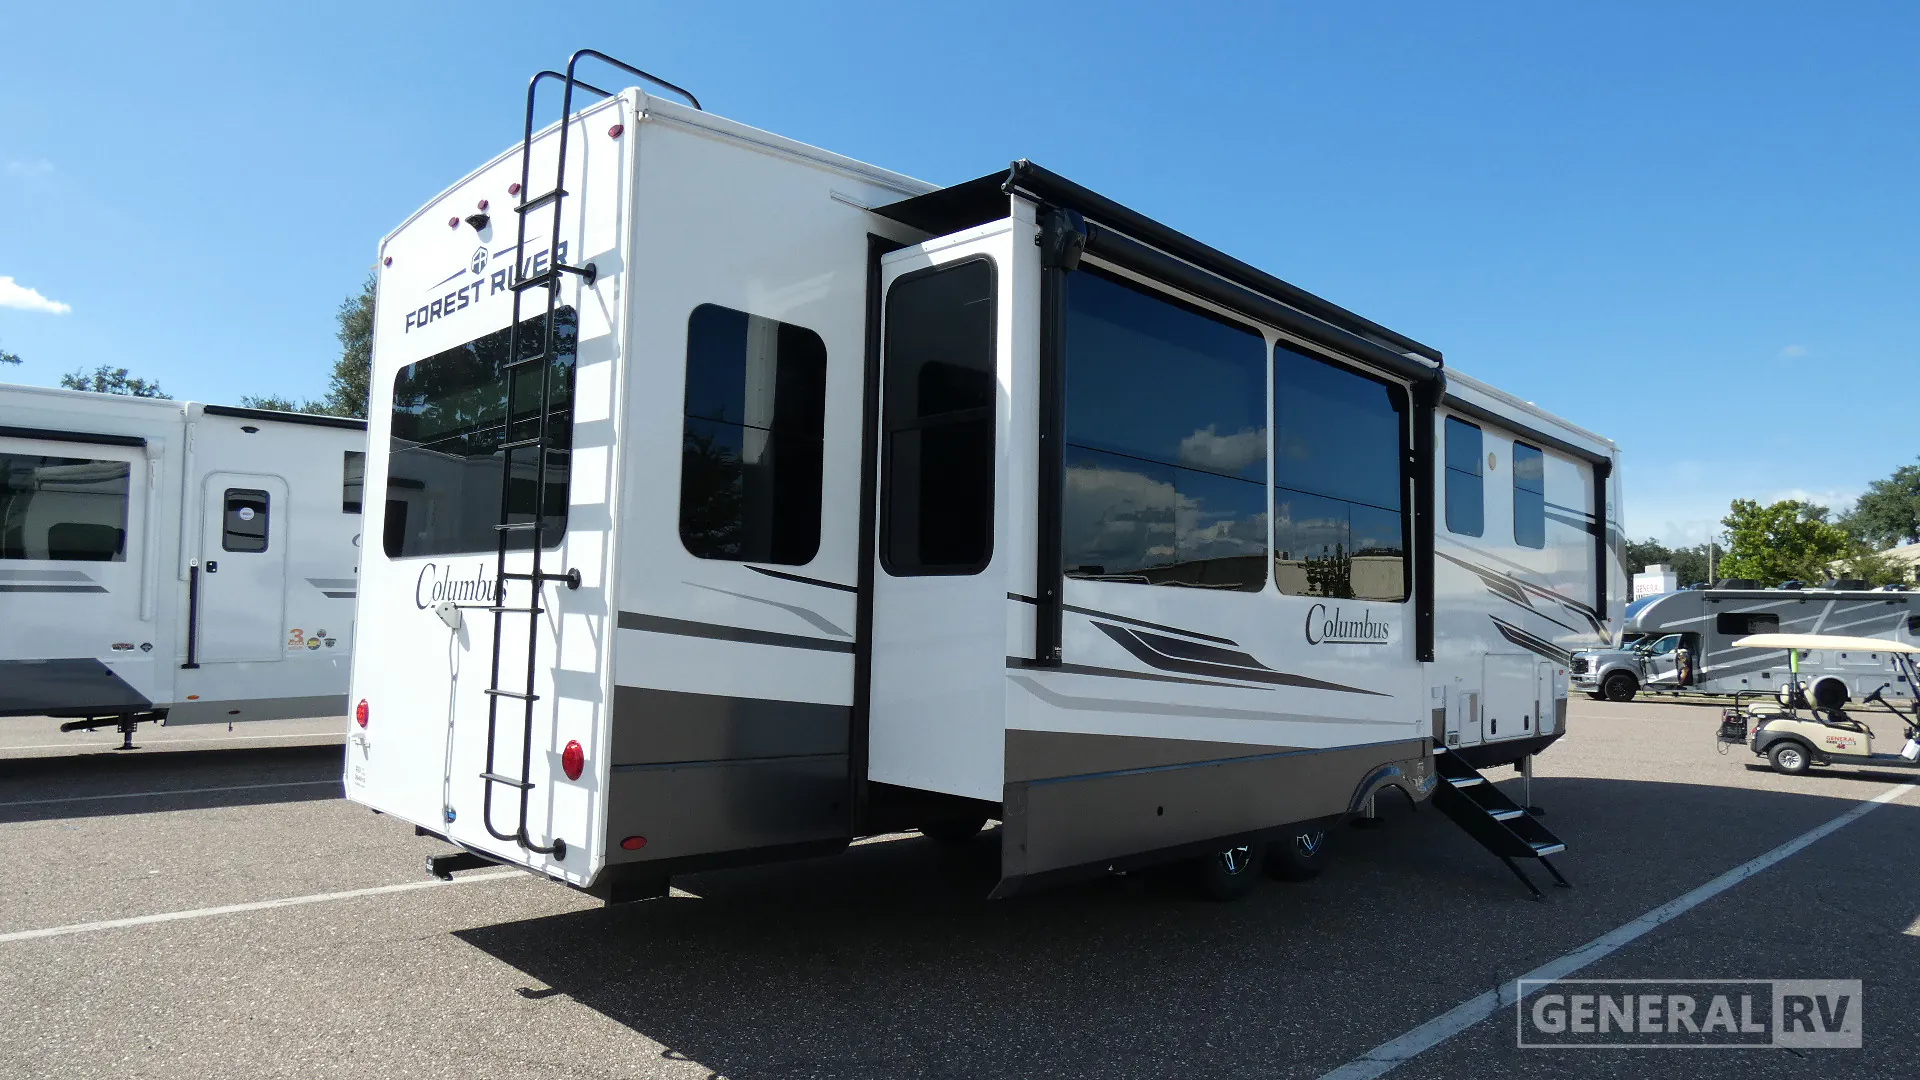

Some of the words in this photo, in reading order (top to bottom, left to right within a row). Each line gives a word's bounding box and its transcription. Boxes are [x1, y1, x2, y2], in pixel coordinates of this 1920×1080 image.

[405, 277, 485, 334] FOREST
[289, 628, 304, 642] 3
[1305, 603, 1389, 645] Columbus
[1826, 735, 1856, 743] GENERAL
